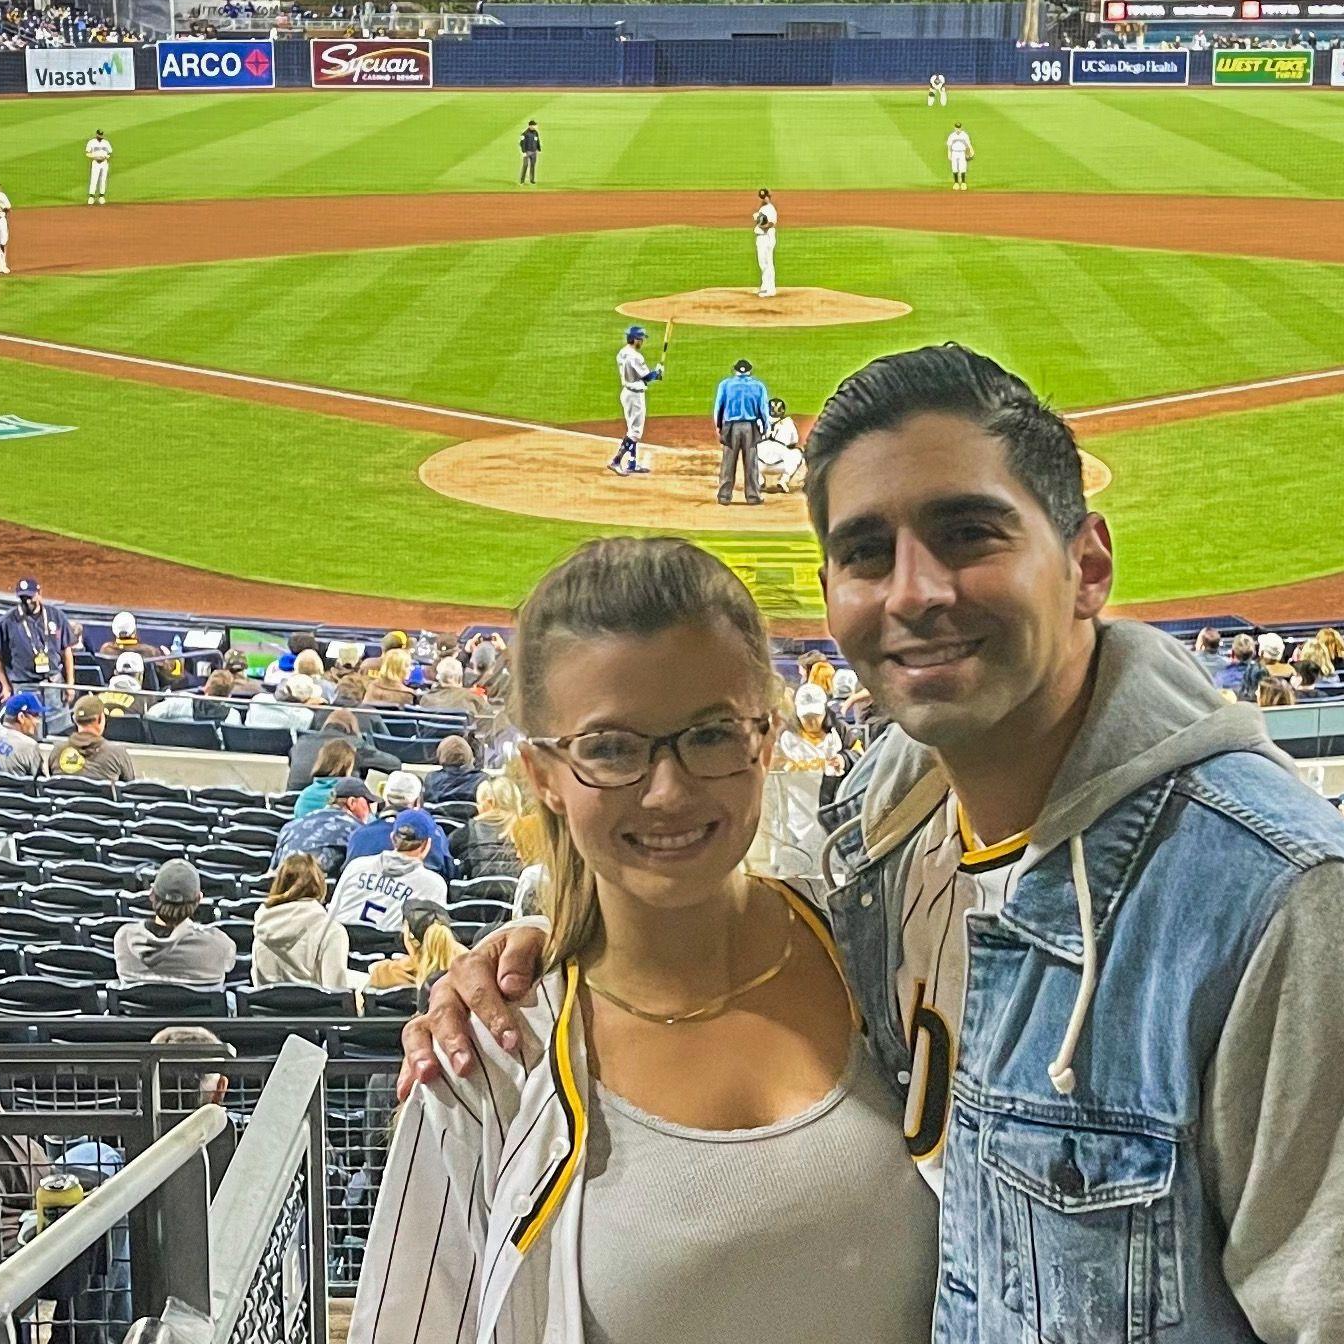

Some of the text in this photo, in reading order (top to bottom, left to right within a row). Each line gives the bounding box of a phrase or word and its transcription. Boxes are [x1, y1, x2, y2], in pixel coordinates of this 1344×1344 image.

[162, 53, 241, 77] ARCO
[321, 43, 420, 82] Sycuan
[1031, 60, 1062, 82] 396
[1081, 60, 1178, 75] UC San Diego Health
[1216, 58, 1308, 73] WEST LAKE
[35, 67, 97, 86] Viasat
[358, 872, 413, 902] SEAGER
